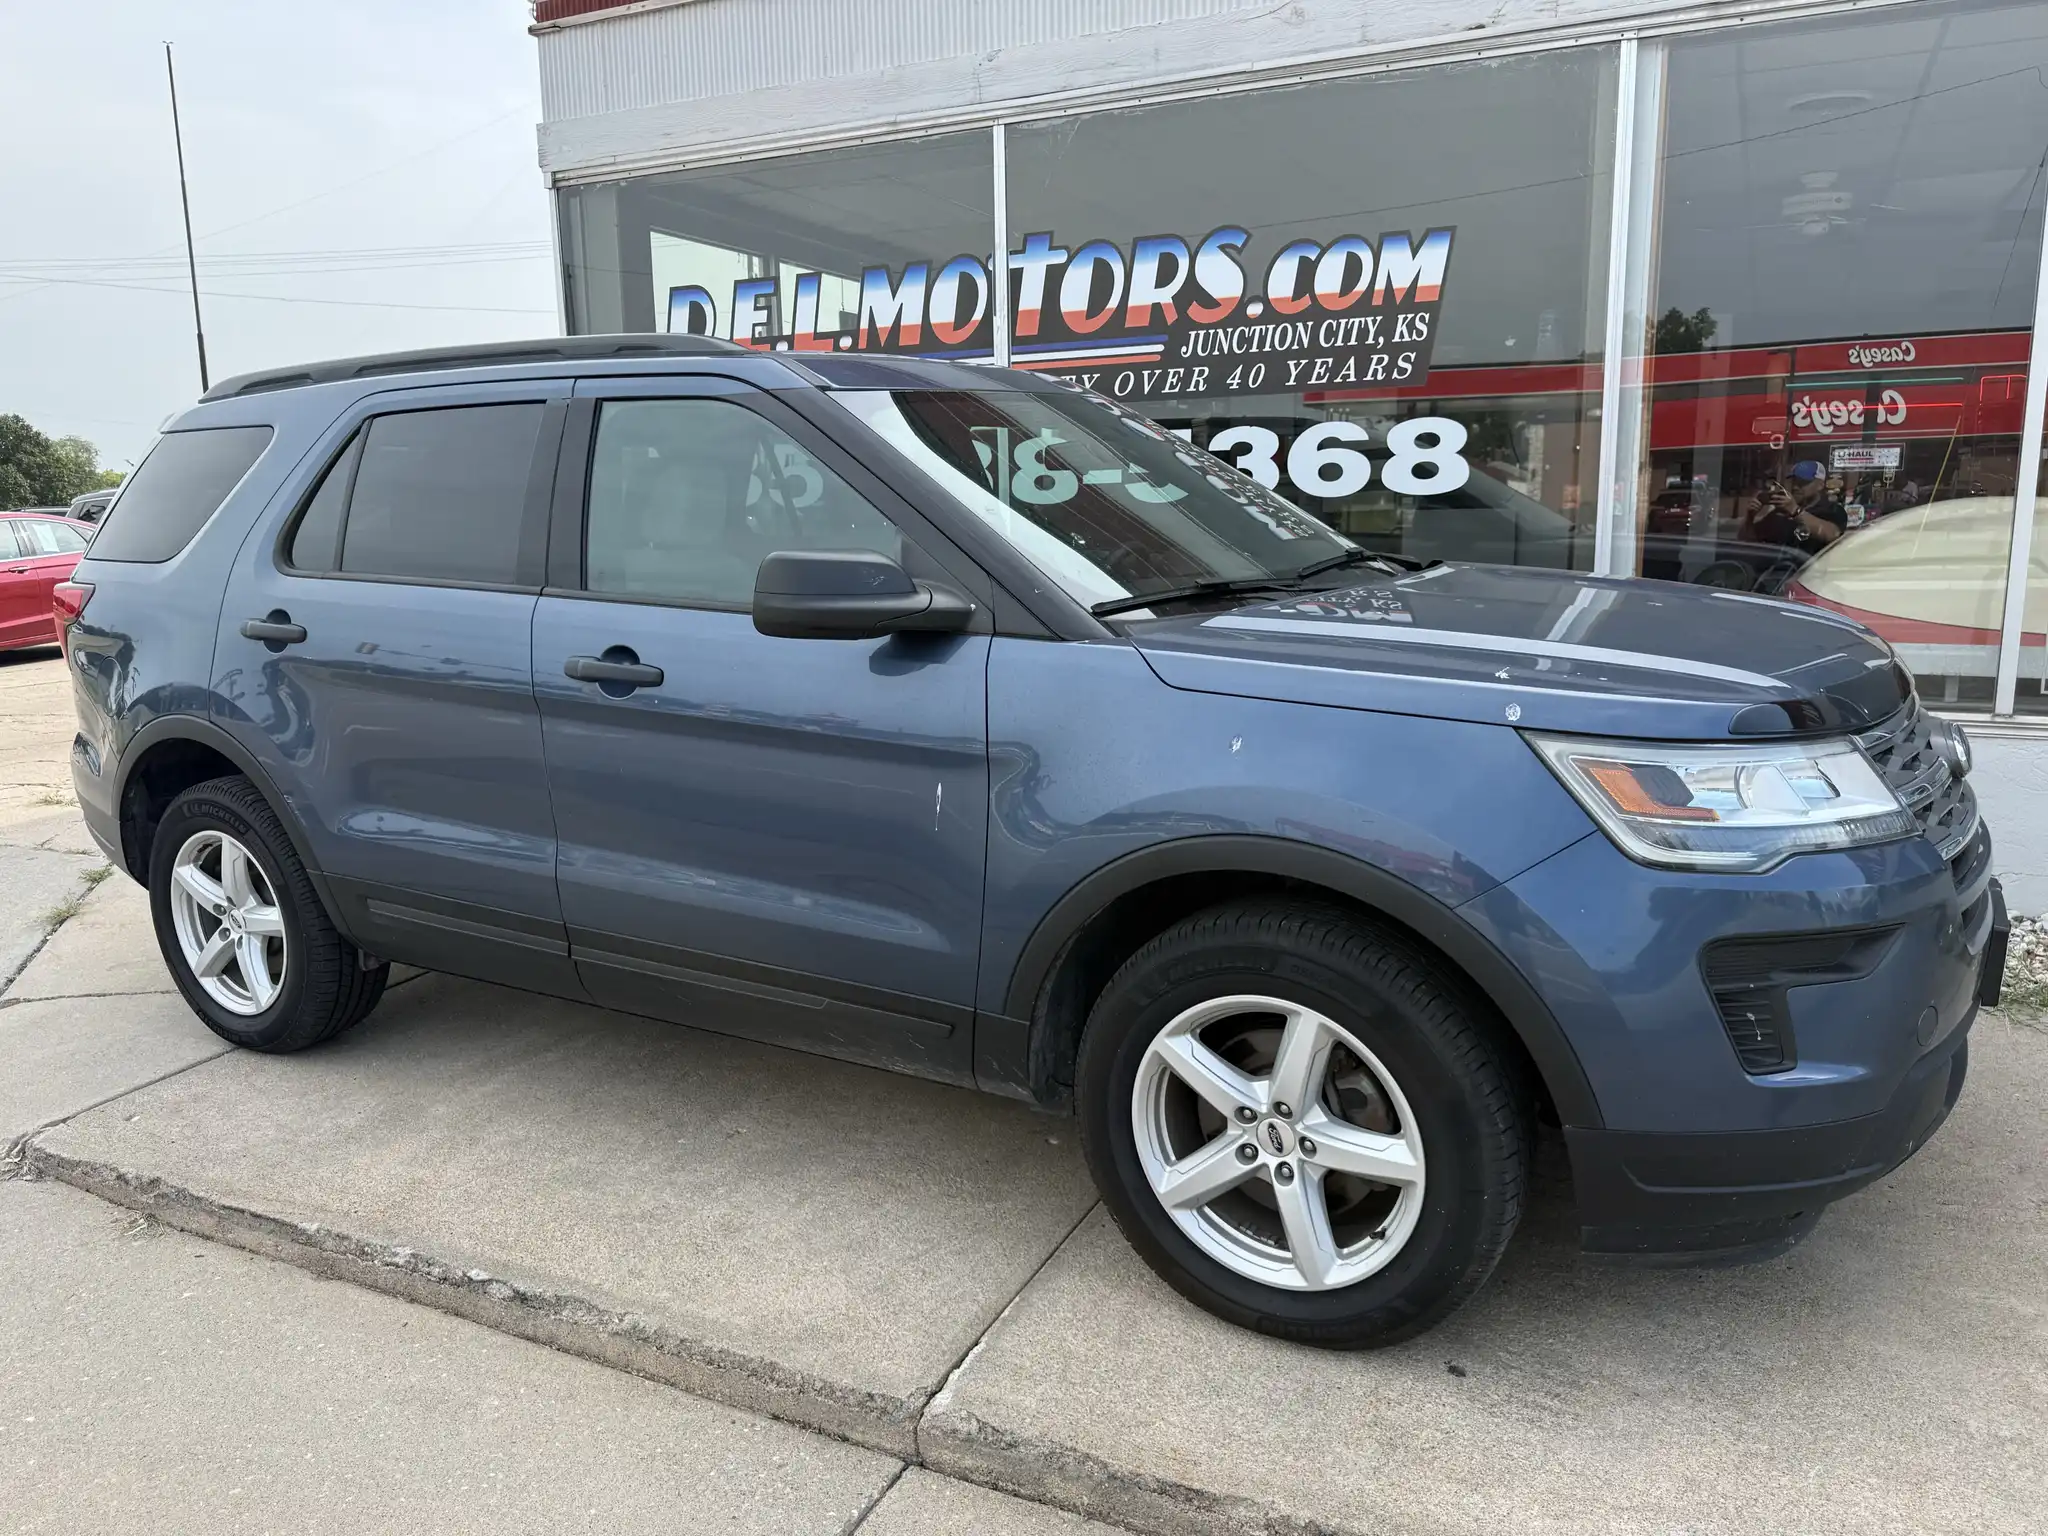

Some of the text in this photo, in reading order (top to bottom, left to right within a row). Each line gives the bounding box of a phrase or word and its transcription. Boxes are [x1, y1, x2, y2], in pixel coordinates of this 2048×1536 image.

[1181, 312, 1431, 358] JUNCTION CITY, KS
[1113, 366, 1208, 397] OVER
[1226, 363, 1267, 390] 40
[1285, 352, 1417, 387] YEARS
